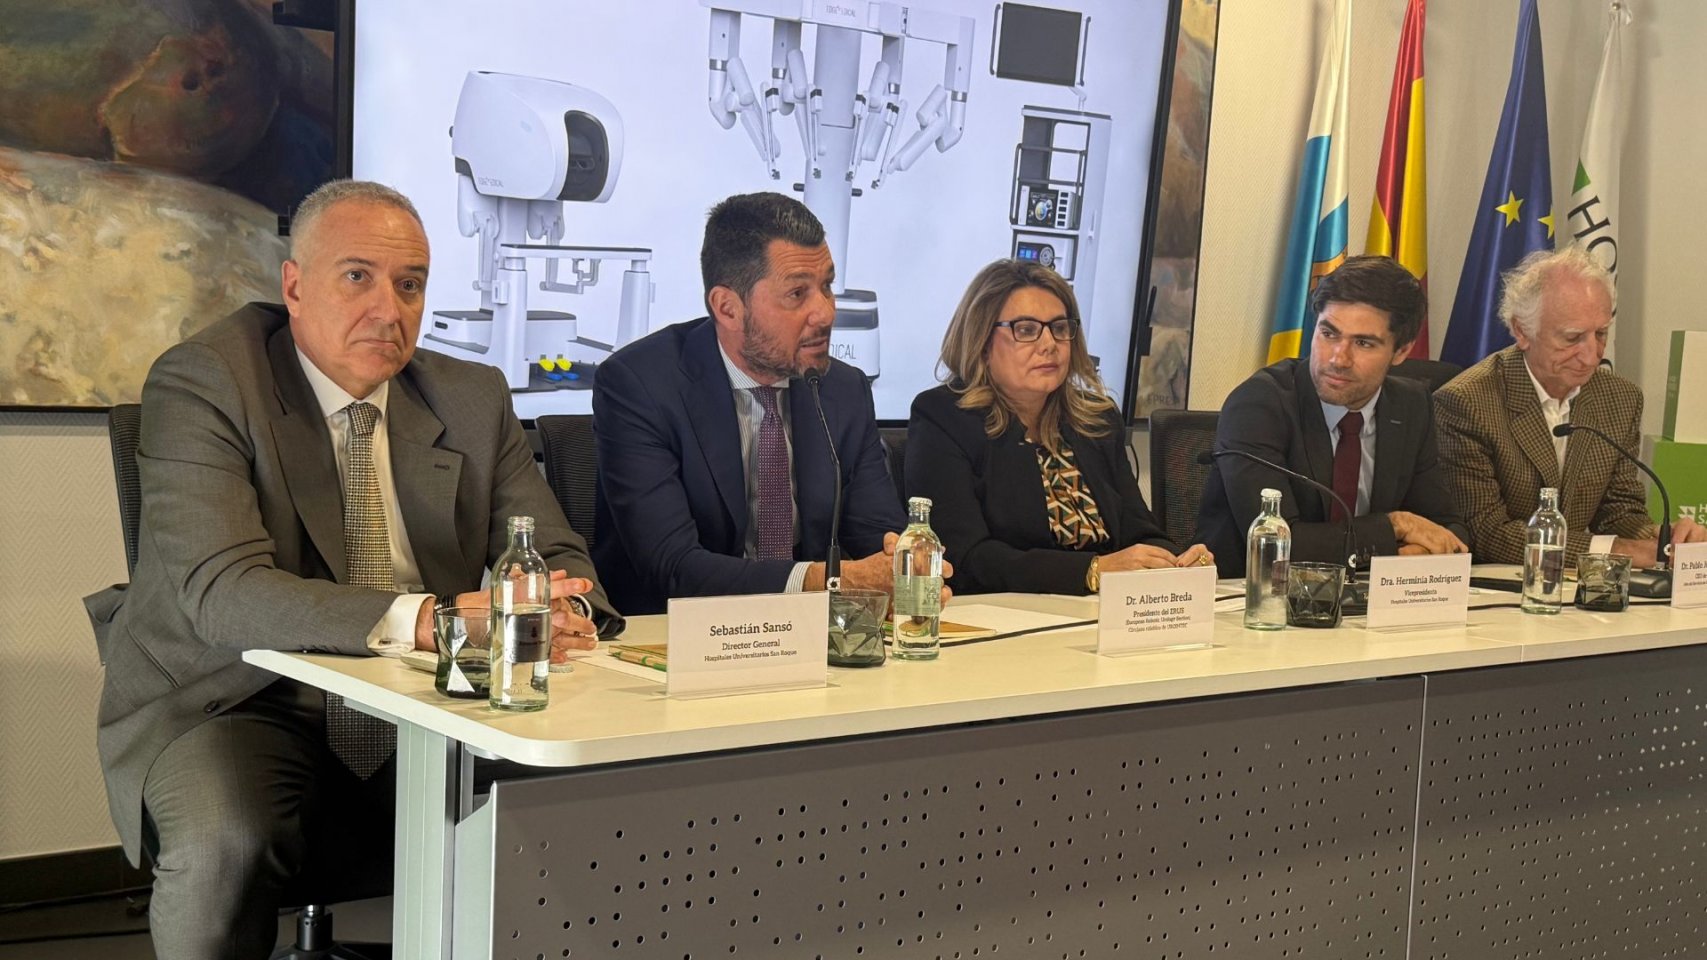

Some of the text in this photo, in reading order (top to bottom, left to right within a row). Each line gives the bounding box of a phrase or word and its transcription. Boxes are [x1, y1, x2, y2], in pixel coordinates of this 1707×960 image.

[1380, 577, 1394, 586] Dra.
[1126, 592, 1192, 606] Dr. Alberto Breda
[1133, 609, 1160, 618] Presidente
[709, 621, 792, 636] Sebastián Sansó
[722, 639, 780, 651] Director General
[704, 654, 732, 662] Hospitales
[732, 651, 769, 660] Universitarios
